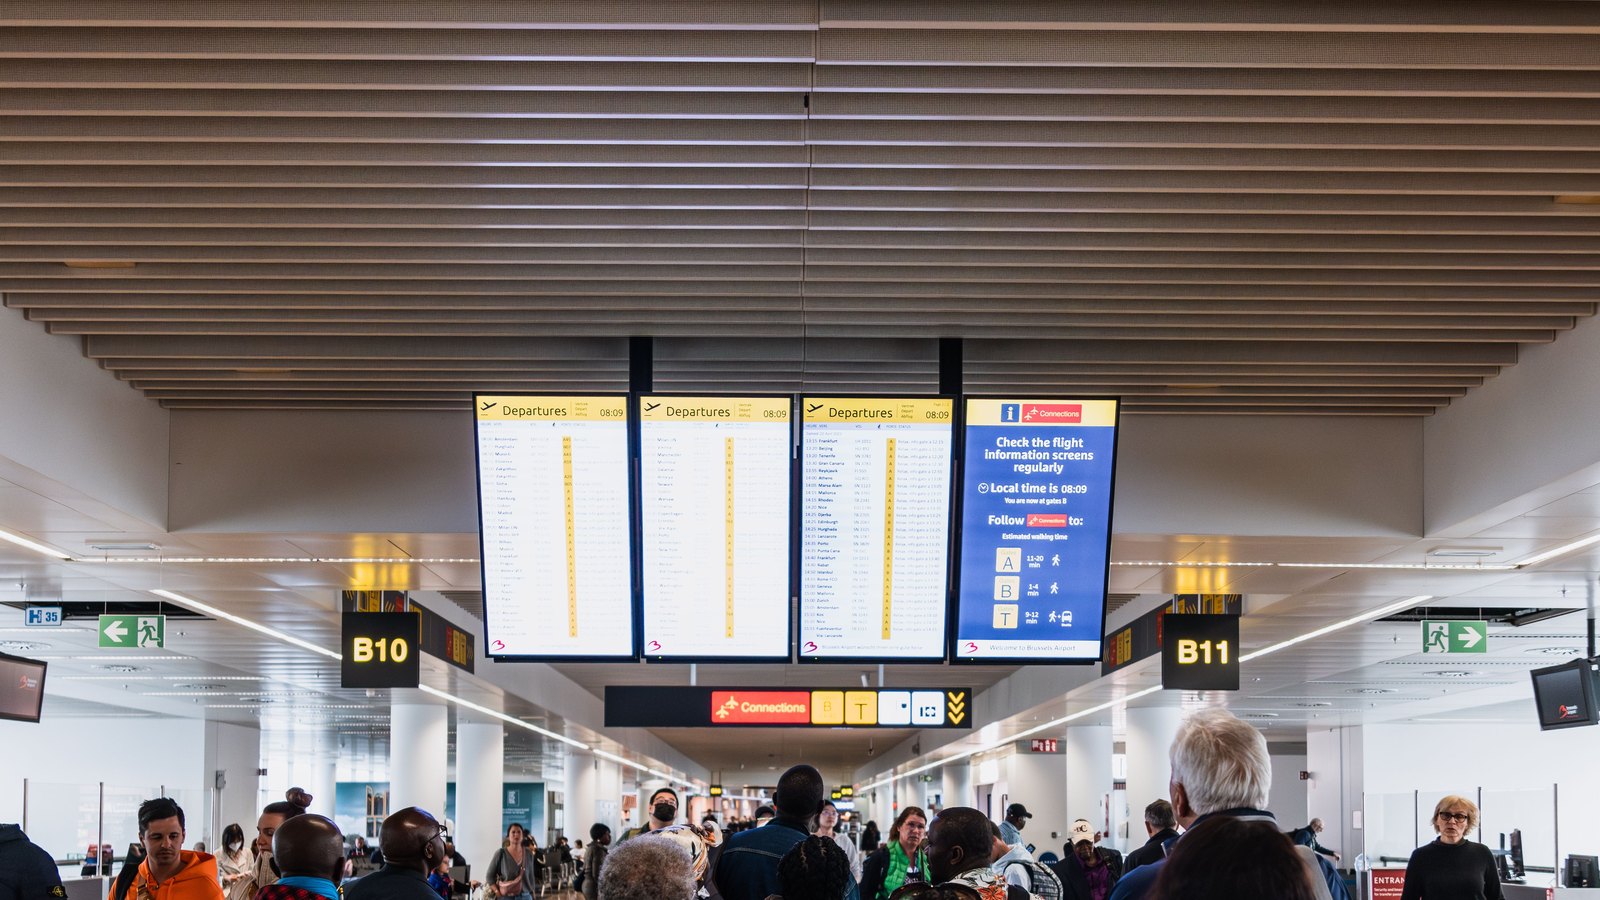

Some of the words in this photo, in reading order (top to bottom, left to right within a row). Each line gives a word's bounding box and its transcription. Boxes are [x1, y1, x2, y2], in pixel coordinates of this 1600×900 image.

[502, 405, 567, 418] Departures
[600, 409, 624, 417] 08:09
[666, 406, 730, 418] Departures
[763, 410, 787, 418] 08:09
[829, 407, 893, 420] Departures
[925, 411, 949, 419] 08:09
[996, 437, 1029, 448] Check
[1032, 437, 1050, 448] the
[1053, 437, 1083, 449] flight
[984, 449, 1050, 460] information
[1052, 452, 1094, 460] screens
[1013, 462, 1064, 475] regularly
[990, 483, 1019, 493] Local
[1021, 483, 1046, 493] time
[1049, 483, 1058, 493] is
[1061, 485, 1087, 493] 08:09
[988, 515, 1024, 525] Follow
[1069, 516, 1083, 525] to:
[1031, 533, 1053, 541] walking
[1003, 556, 1013, 570] A
[1001, 585, 1012, 598] B
[45, 612, 58, 622] 35
[1000, 612, 1011, 626] T
[353, 637, 408, 663] B10
[1178, 639, 1228, 664] B11
[741, 701, 806, 714] Connections
[854, 703, 868, 720] T
